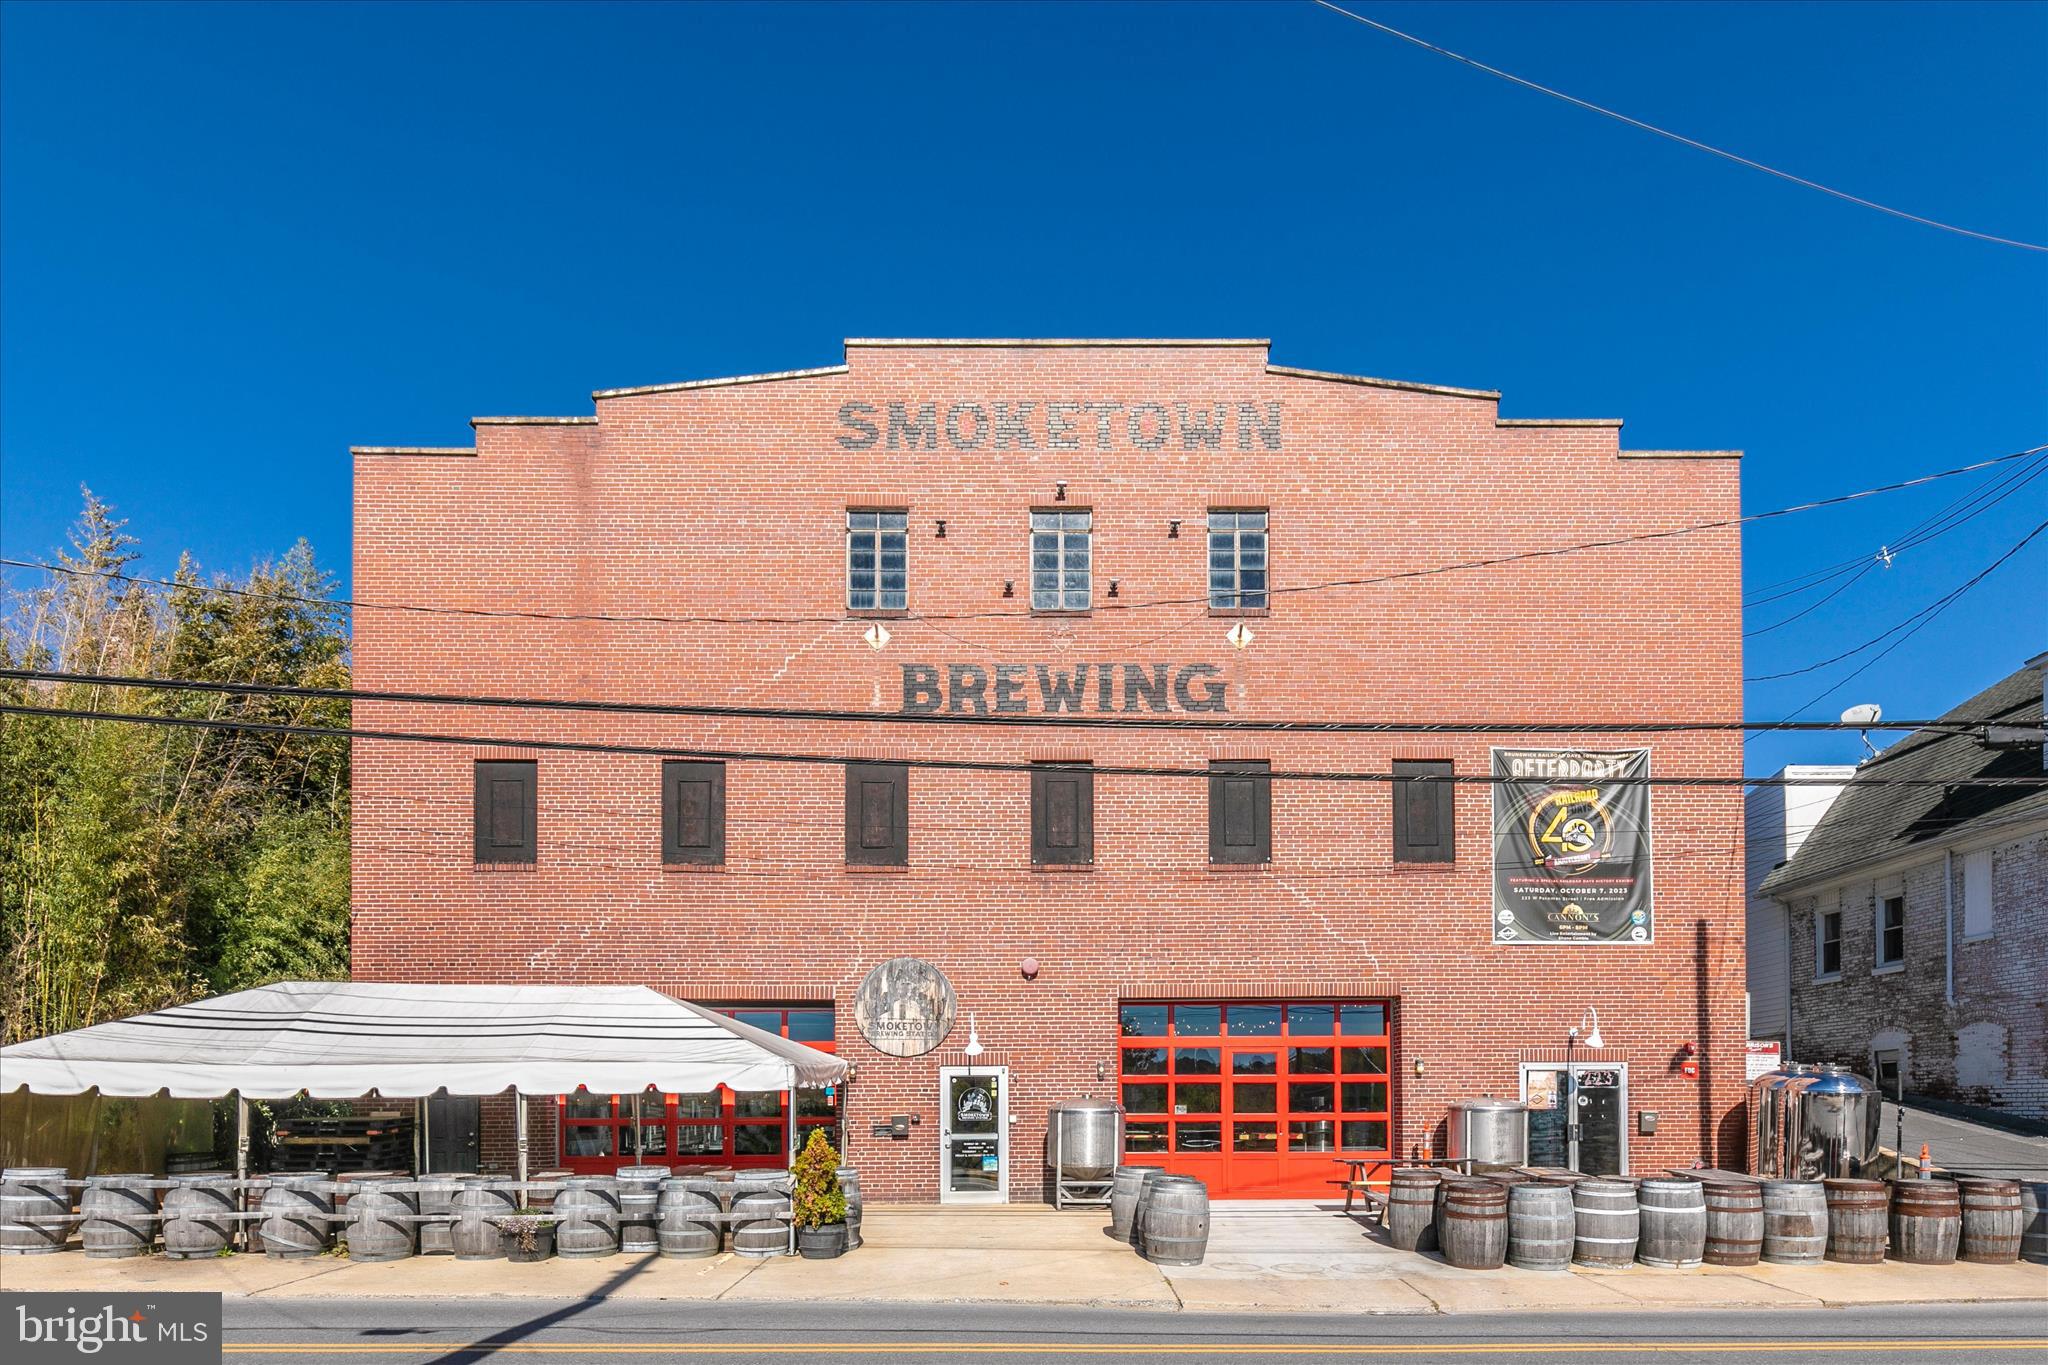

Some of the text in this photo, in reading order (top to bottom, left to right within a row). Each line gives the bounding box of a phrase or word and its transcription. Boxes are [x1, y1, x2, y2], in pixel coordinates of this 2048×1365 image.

[835, 401, 1286, 451] SMOKETOWN
[900, 662, 1230, 715] BREWING
[1512, 758, 1626, 777] AFTERPARTY
[1555, 788, 1599, 806] RAILROAD
[1547, 912, 1600, 922] CANNON'S
